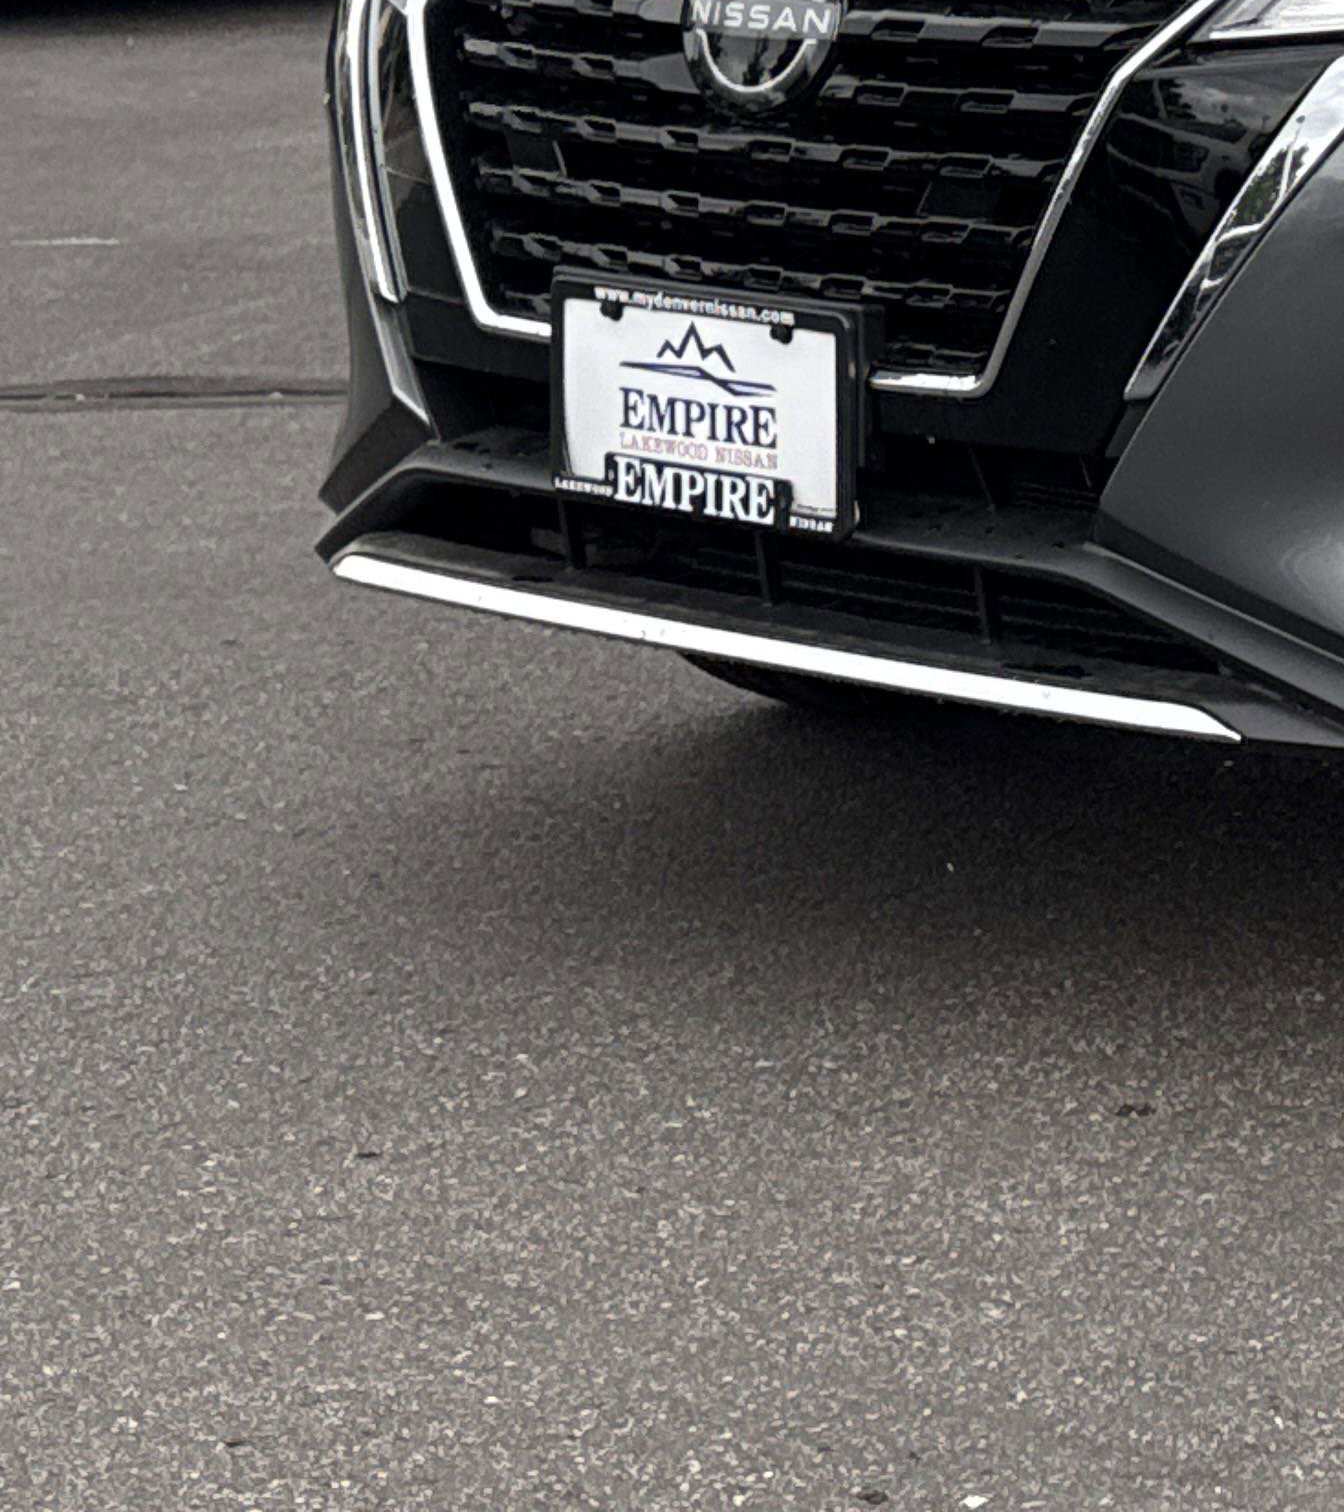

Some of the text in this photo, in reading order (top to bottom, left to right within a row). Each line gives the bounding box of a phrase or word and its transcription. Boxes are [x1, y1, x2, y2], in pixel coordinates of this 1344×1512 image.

[619, 386, 778, 449] EMPIRE
[619, 431, 778, 471] LAKEWOOD NISSAN
[613, 455, 775, 525] EMPIRE
